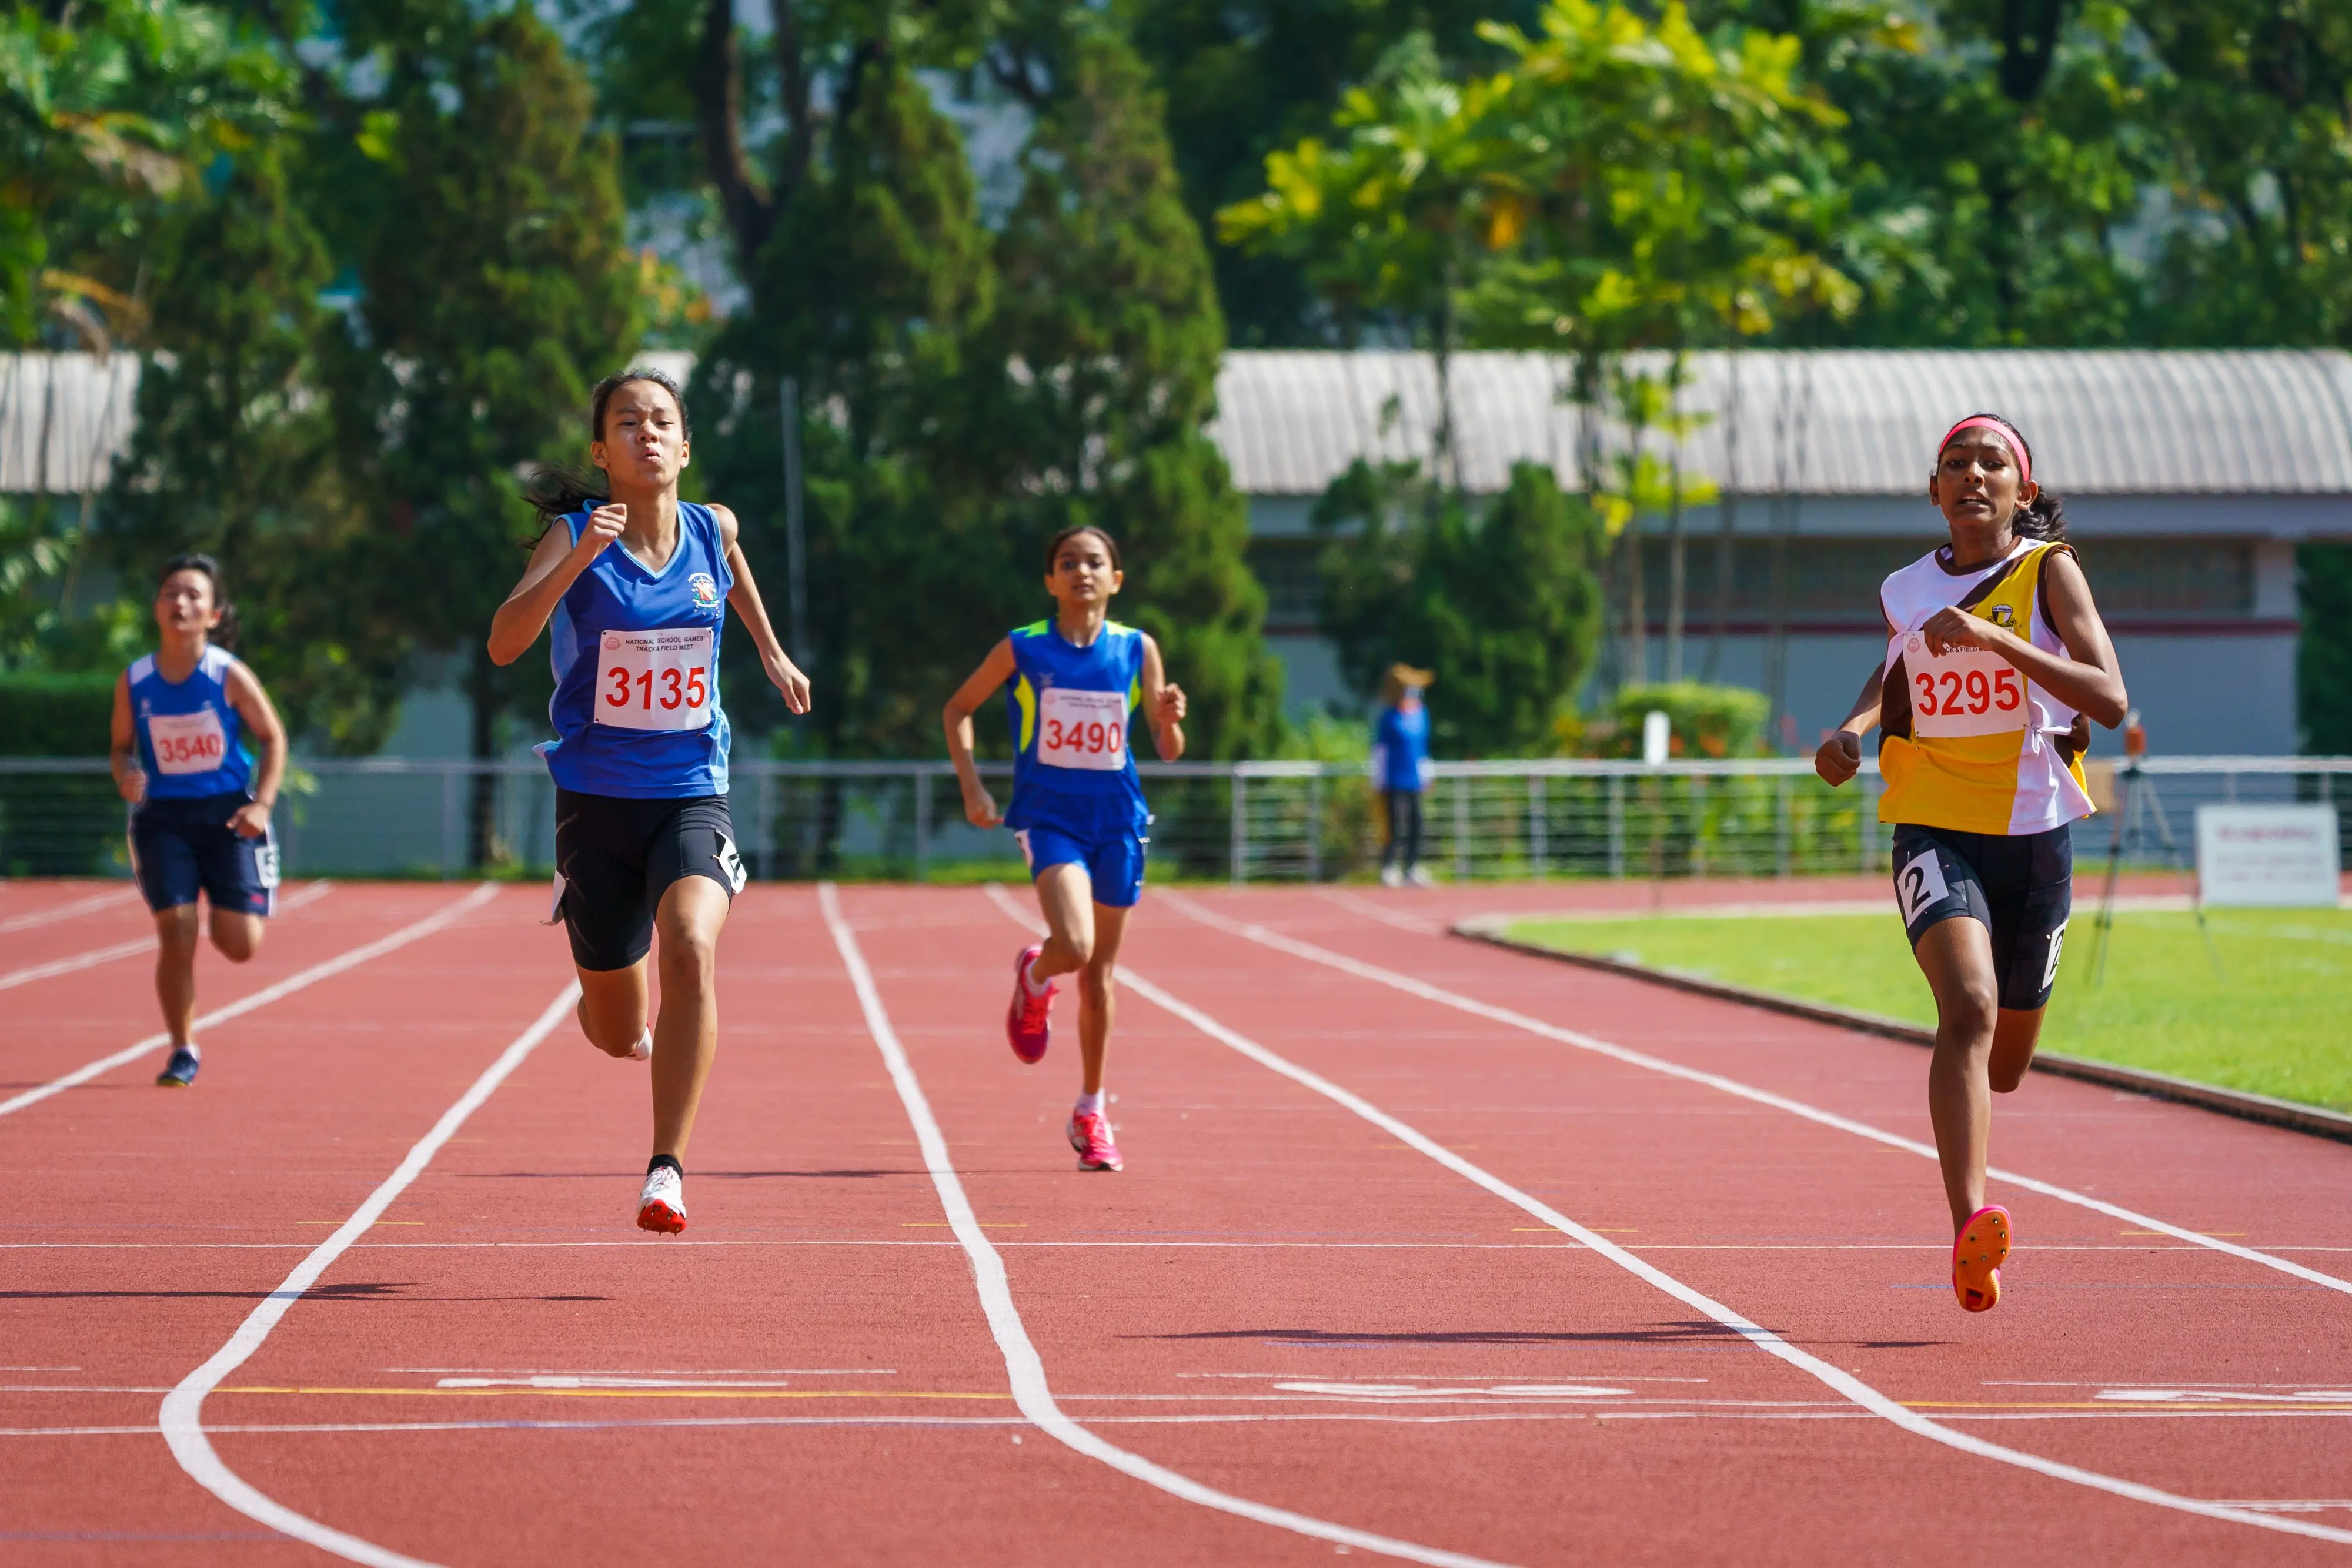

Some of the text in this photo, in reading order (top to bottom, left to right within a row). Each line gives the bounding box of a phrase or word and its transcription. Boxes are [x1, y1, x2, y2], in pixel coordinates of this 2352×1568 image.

[605, 667, 705, 710] 3135
[1915, 668, 2020, 716] 3295
[159, 733, 221, 763] 3540
[1045, 719, 1121, 753] 3490
[1905, 866, 1932, 915] 2
[2049, 928, 2065, 977] 2
